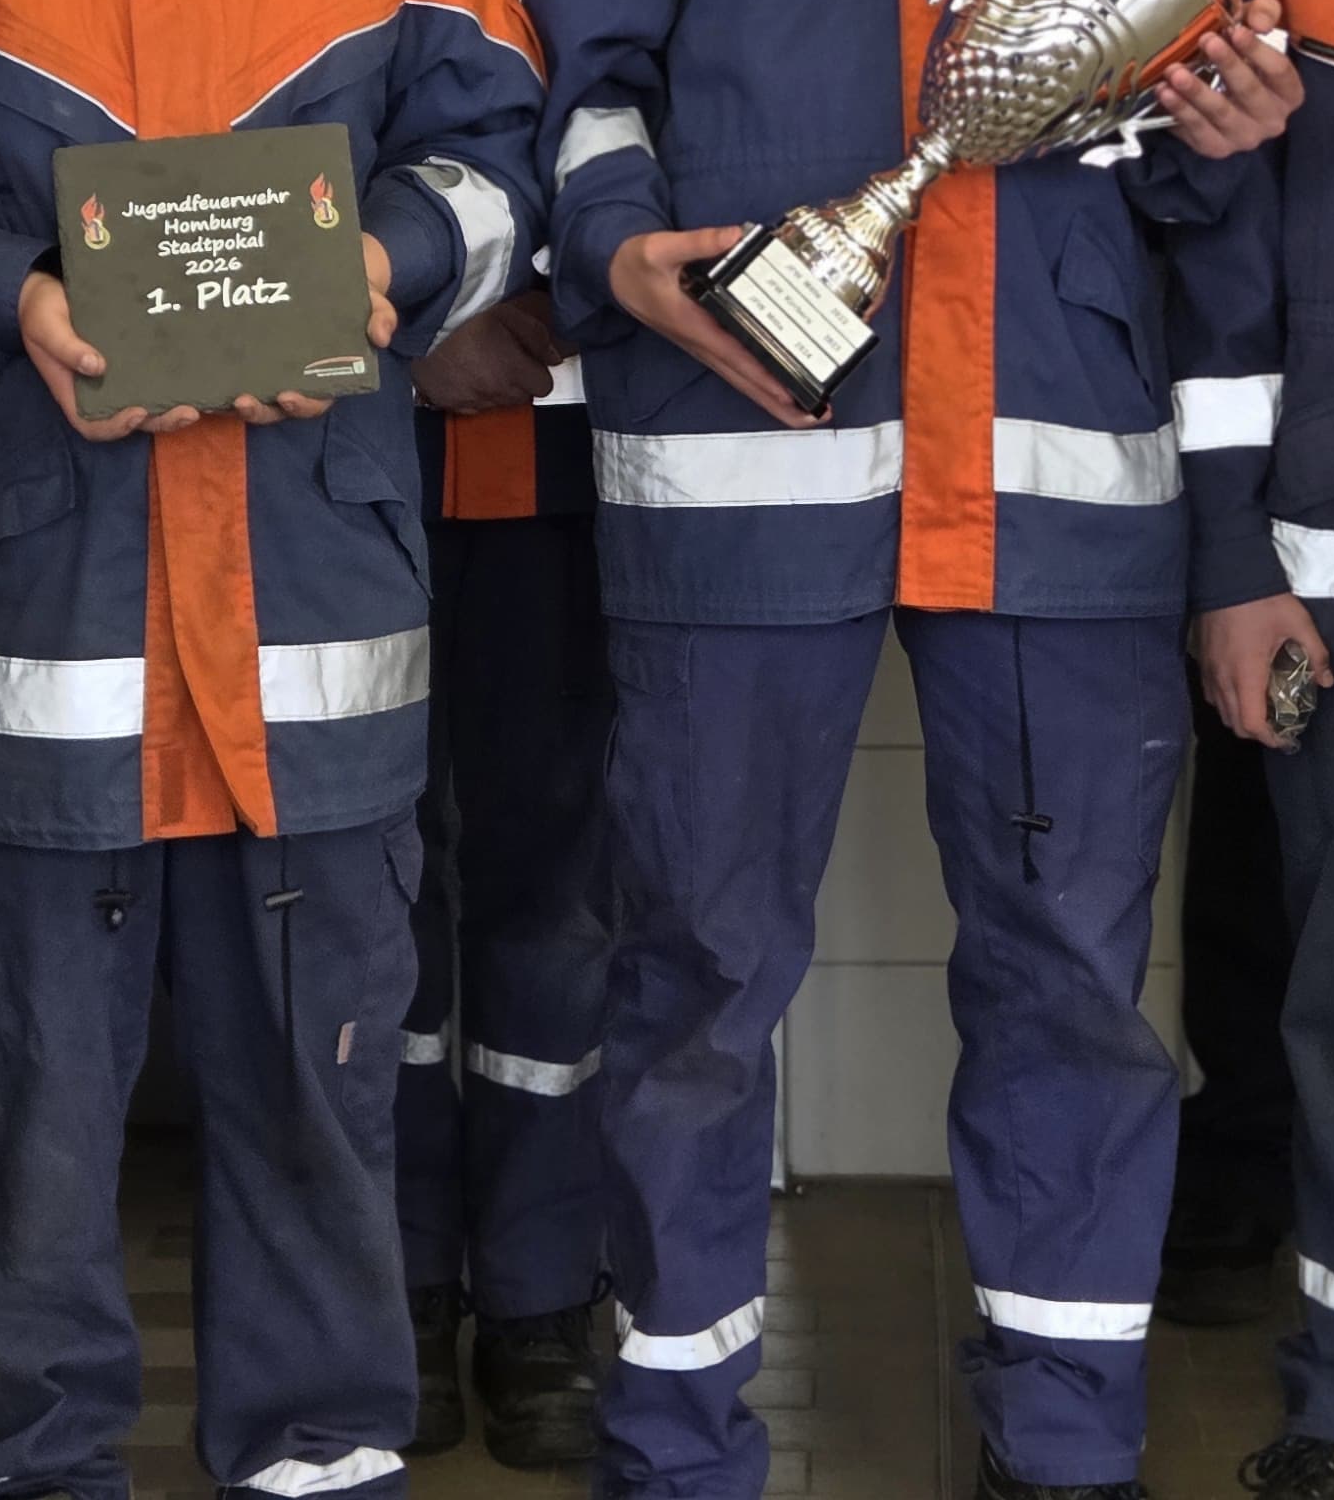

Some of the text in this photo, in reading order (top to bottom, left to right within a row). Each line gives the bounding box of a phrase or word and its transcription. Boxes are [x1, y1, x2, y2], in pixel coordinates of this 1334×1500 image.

[121, 188, 291, 220] Jugendfeuerwehr
[164, 213, 254, 235] Homburg
[157, 230, 265, 257] Stadtpokal
[185, 256, 243, 276] 2026
[146, 277, 291, 314] 1. Platz
